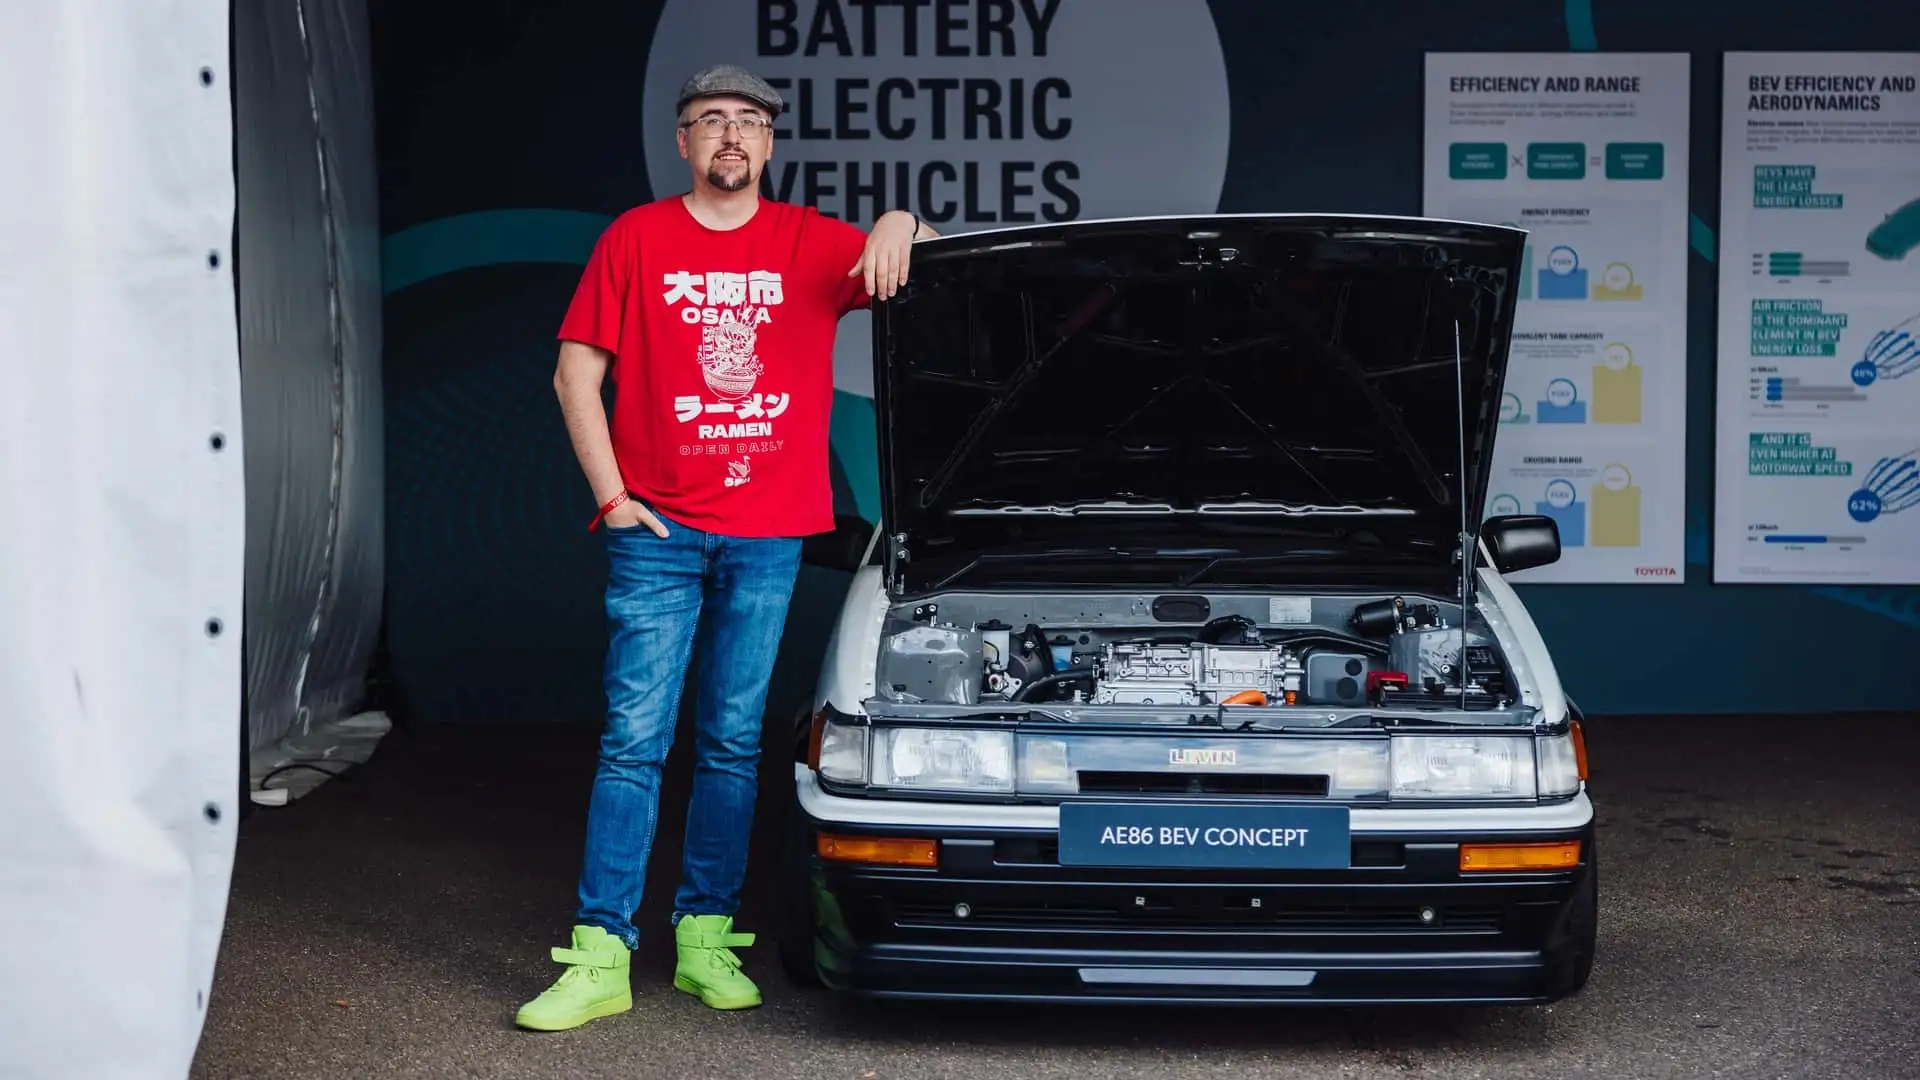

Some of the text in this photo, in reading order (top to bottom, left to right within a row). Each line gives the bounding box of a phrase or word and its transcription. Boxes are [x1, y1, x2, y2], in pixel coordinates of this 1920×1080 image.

[757, 0, 1061, 57] BATTERY
[1449, 77, 1641, 93] EFFICIENCY AND RANGE
[1748, 76, 1916, 92] BEV EFFICIENCY AND
[1748, 95, 1880, 111] AERODYNAMICS
[663, 270, 784, 306] 大阪市
[674, 393, 790, 423] ラーメン
[698, 422, 773, 439] RAMEN
[679, 440, 784, 456] OPEN DAILY
[1851, 499, 1878, 512] 62%
[1635, 567, 1676, 577] TOYOTA
[1101, 826, 1309, 847] AE86 BEV CONCEPT
